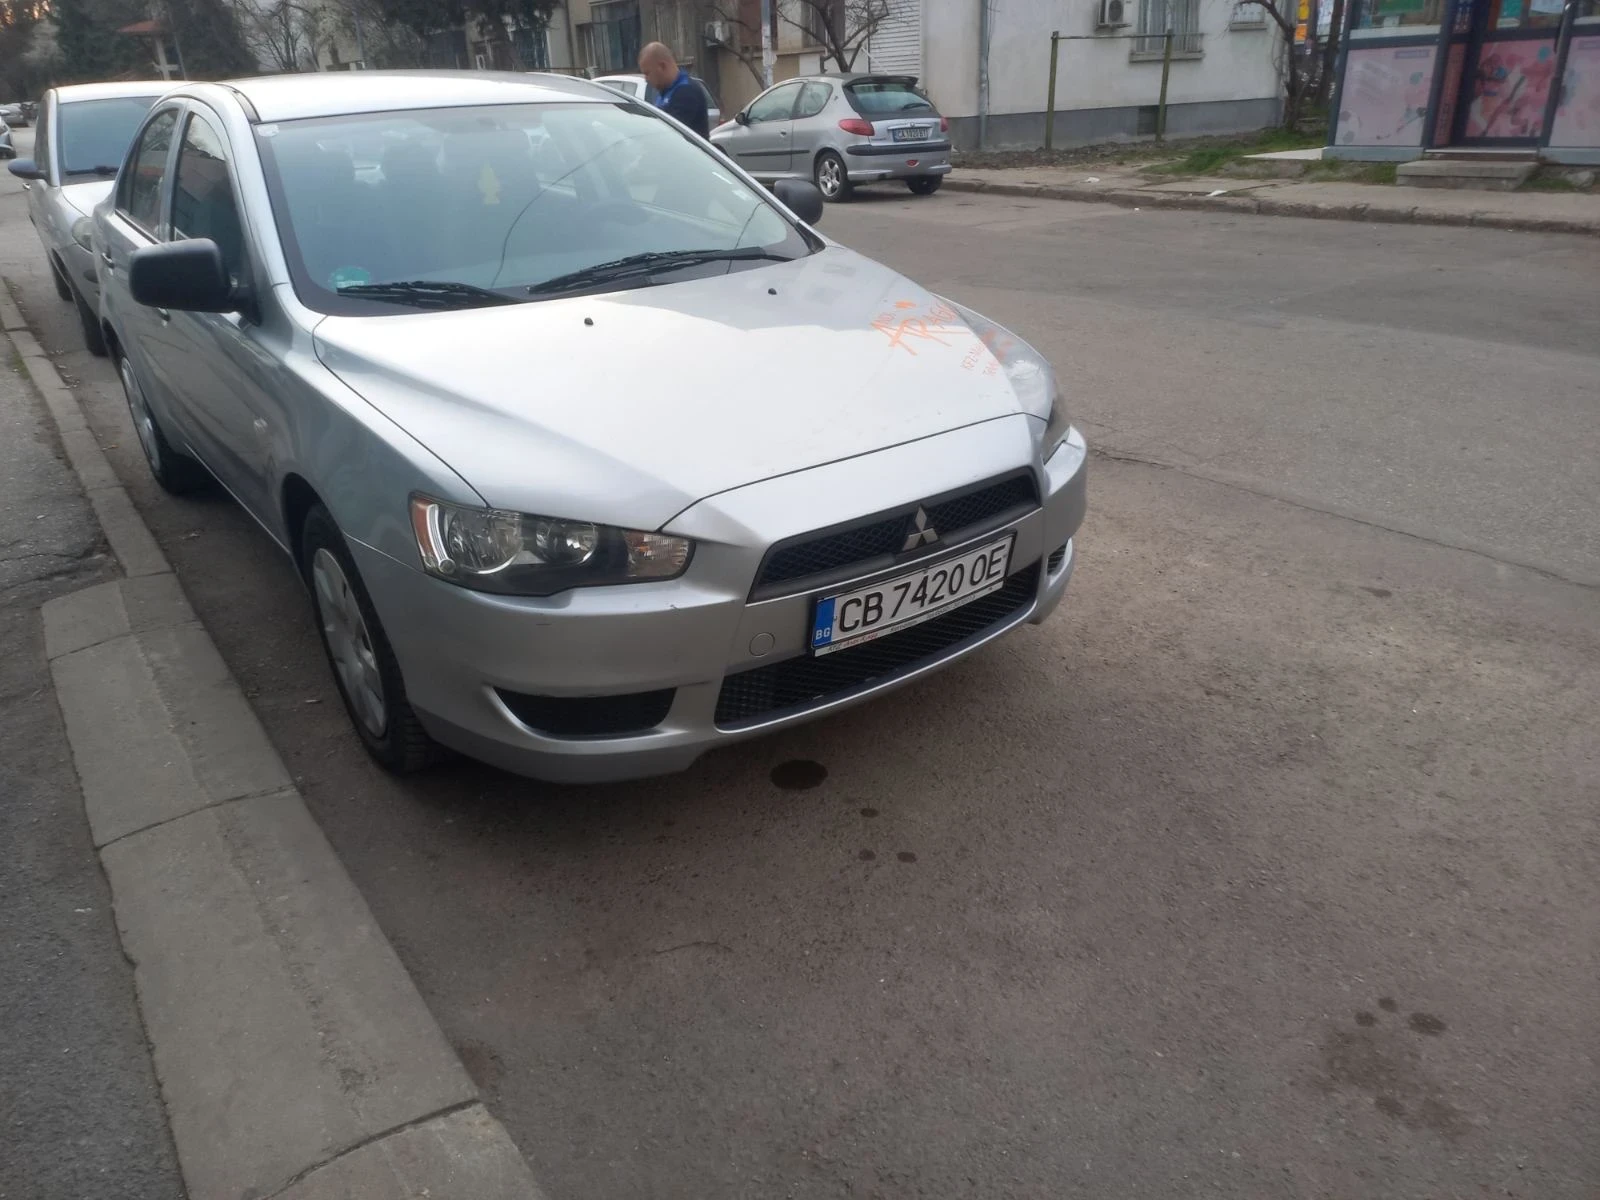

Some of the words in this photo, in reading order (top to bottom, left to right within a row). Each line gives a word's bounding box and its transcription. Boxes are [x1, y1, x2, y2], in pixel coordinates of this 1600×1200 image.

[839, 591, 884, 633] CB
[890, 563, 965, 619] 7420
[969, 544, 1006, 586] OE
[815, 627, 831, 641] BG
